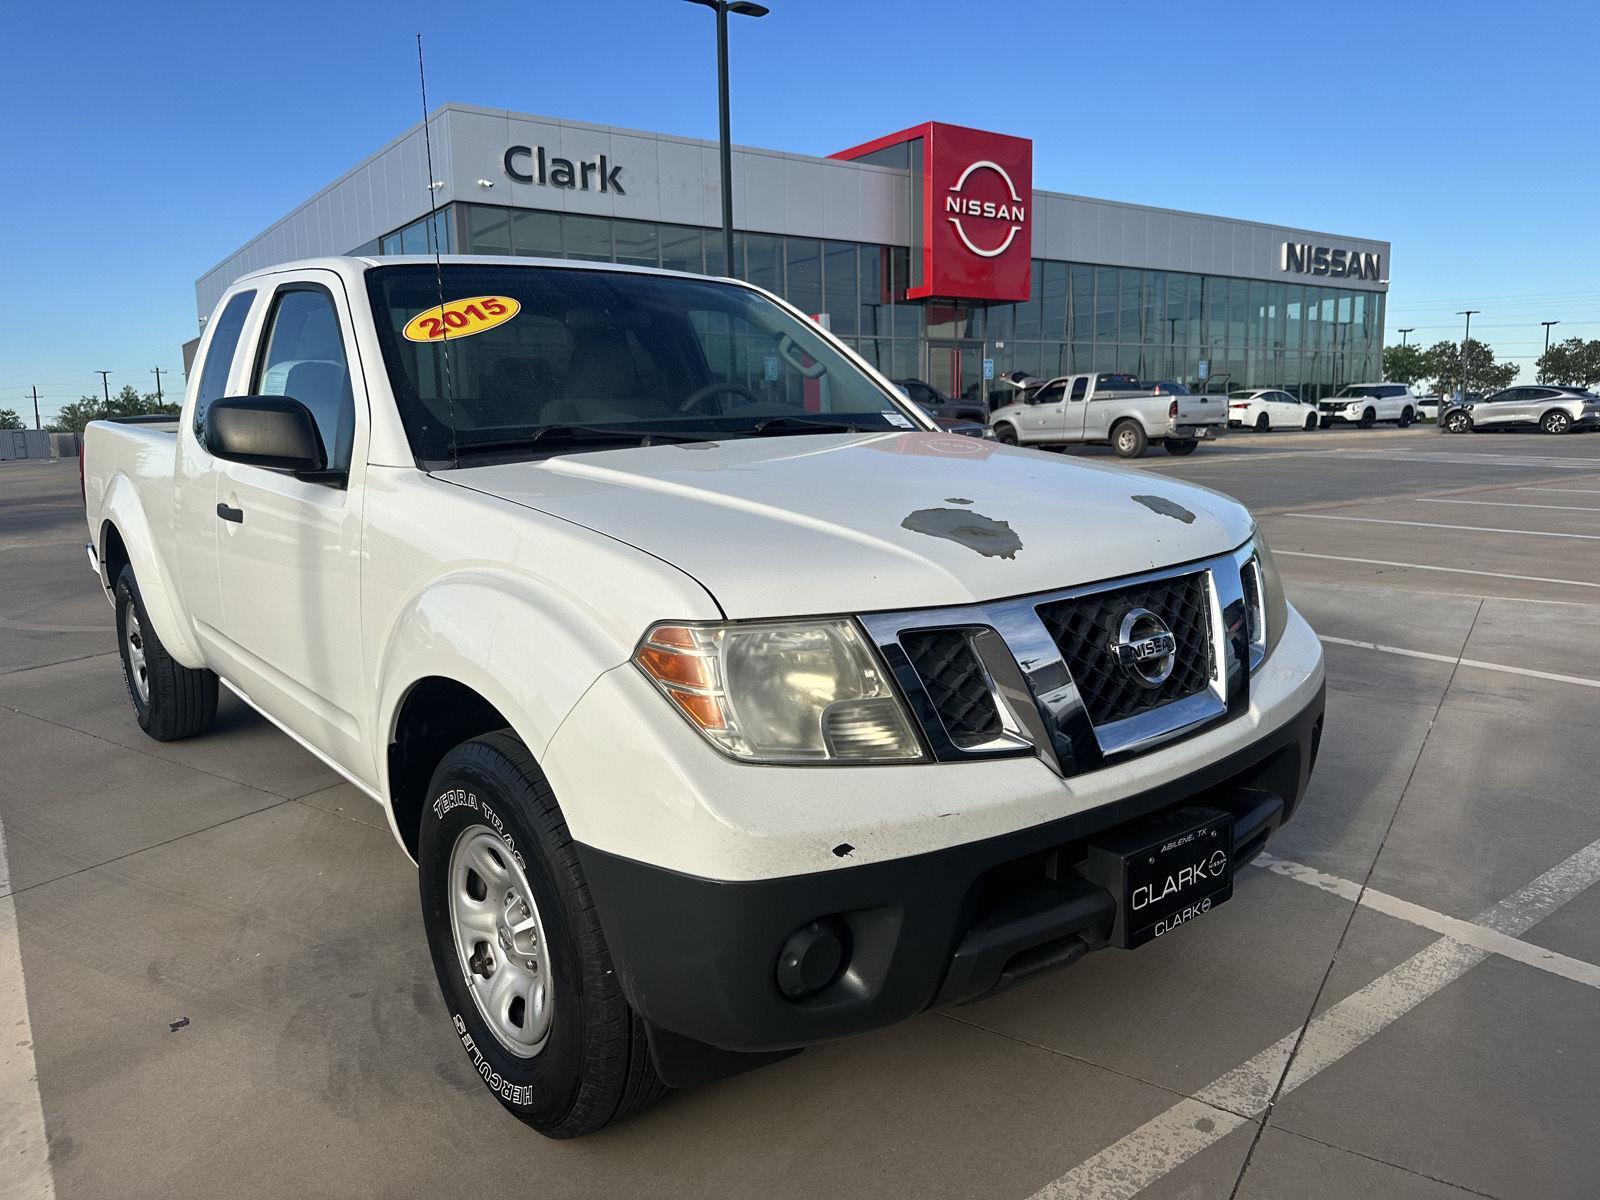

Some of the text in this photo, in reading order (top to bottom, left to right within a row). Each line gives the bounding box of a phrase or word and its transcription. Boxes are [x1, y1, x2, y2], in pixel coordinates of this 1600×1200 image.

[504, 145, 626, 195] Clark
[946, 196, 1025, 222] NISSAN
[1281, 243, 1381, 281] NISSAN
[419, 298, 508, 339] 2015
[433, 790, 478, 819] TERRA
[1161, 828, 1207, 853] ABILENE, TX
[1132, 859, 1207, 910] CLARK
[1155, 902, 1201, 936] CLARK
[453, 1014, 533, 1105] HERCULES
